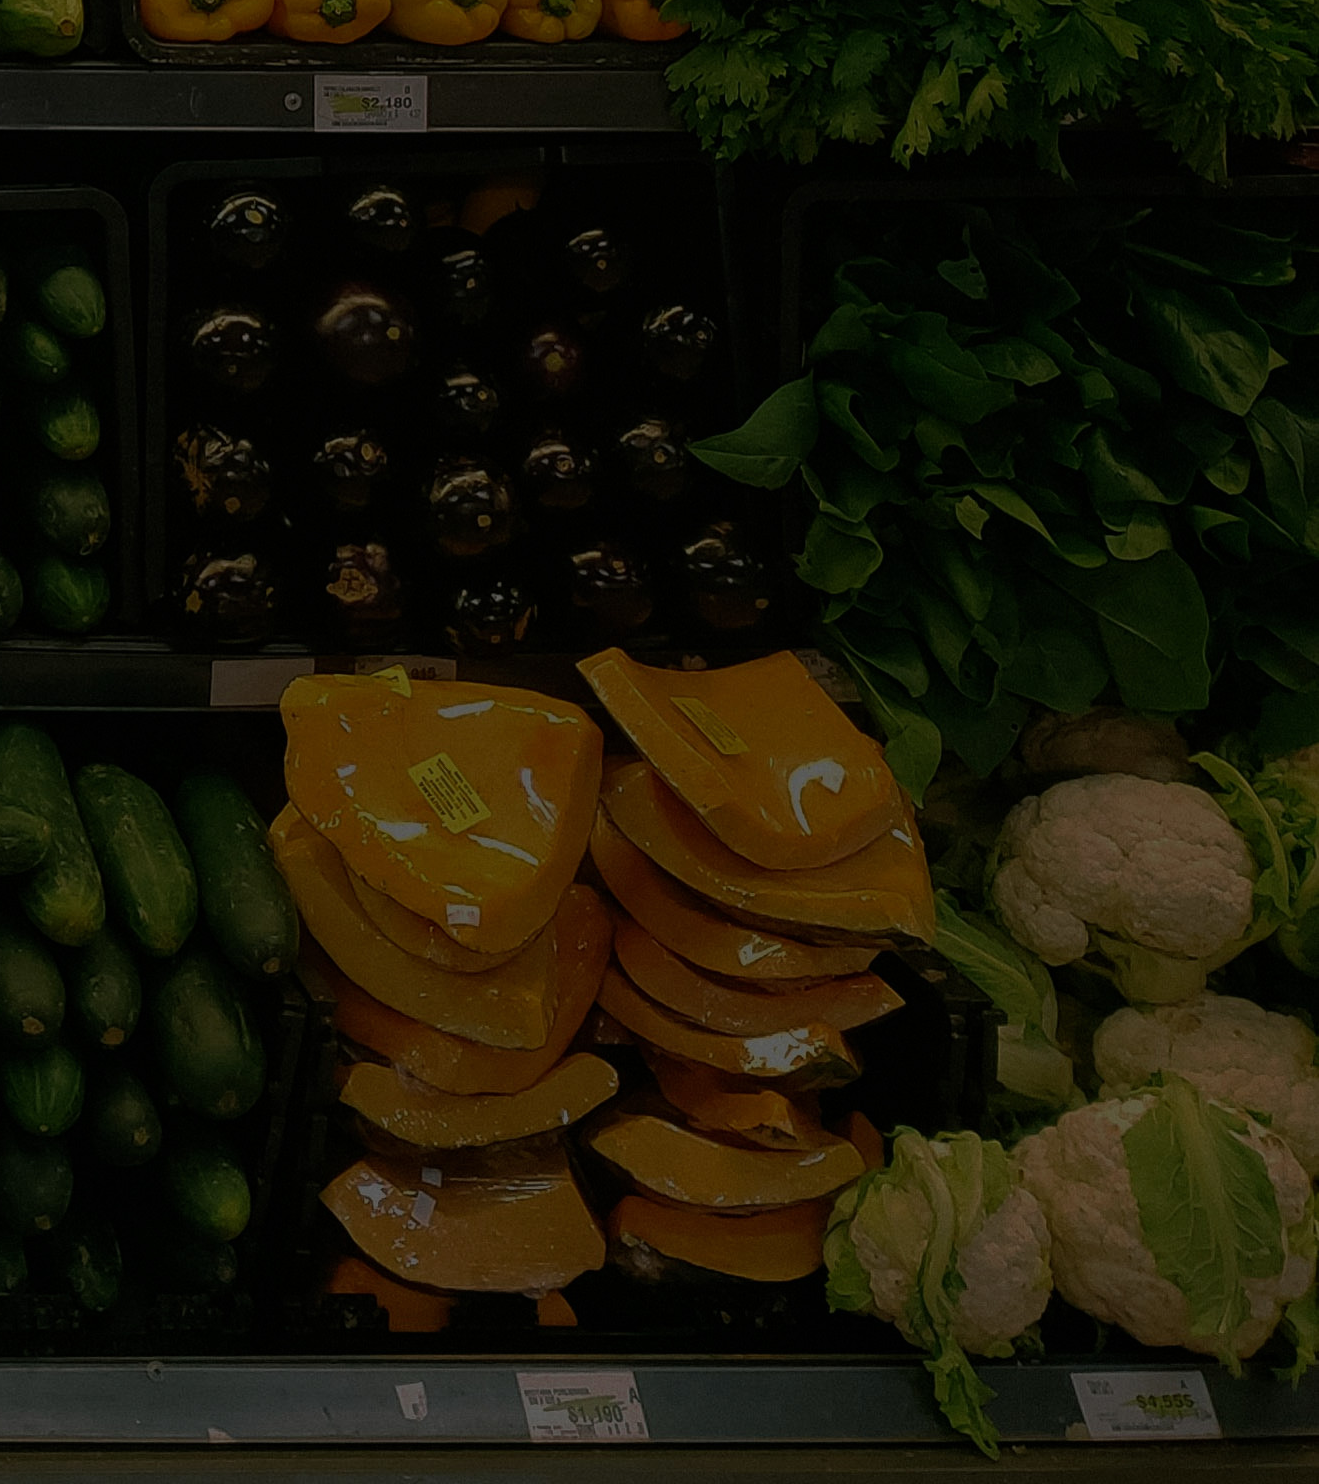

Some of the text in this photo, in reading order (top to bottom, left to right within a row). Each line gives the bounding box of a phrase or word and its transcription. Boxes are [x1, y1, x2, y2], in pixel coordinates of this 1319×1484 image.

[362, 97, 412, 111] $2,180
[629, 1387, 641, 1404] A
[568, 1405, 623, 1424] $1,190
